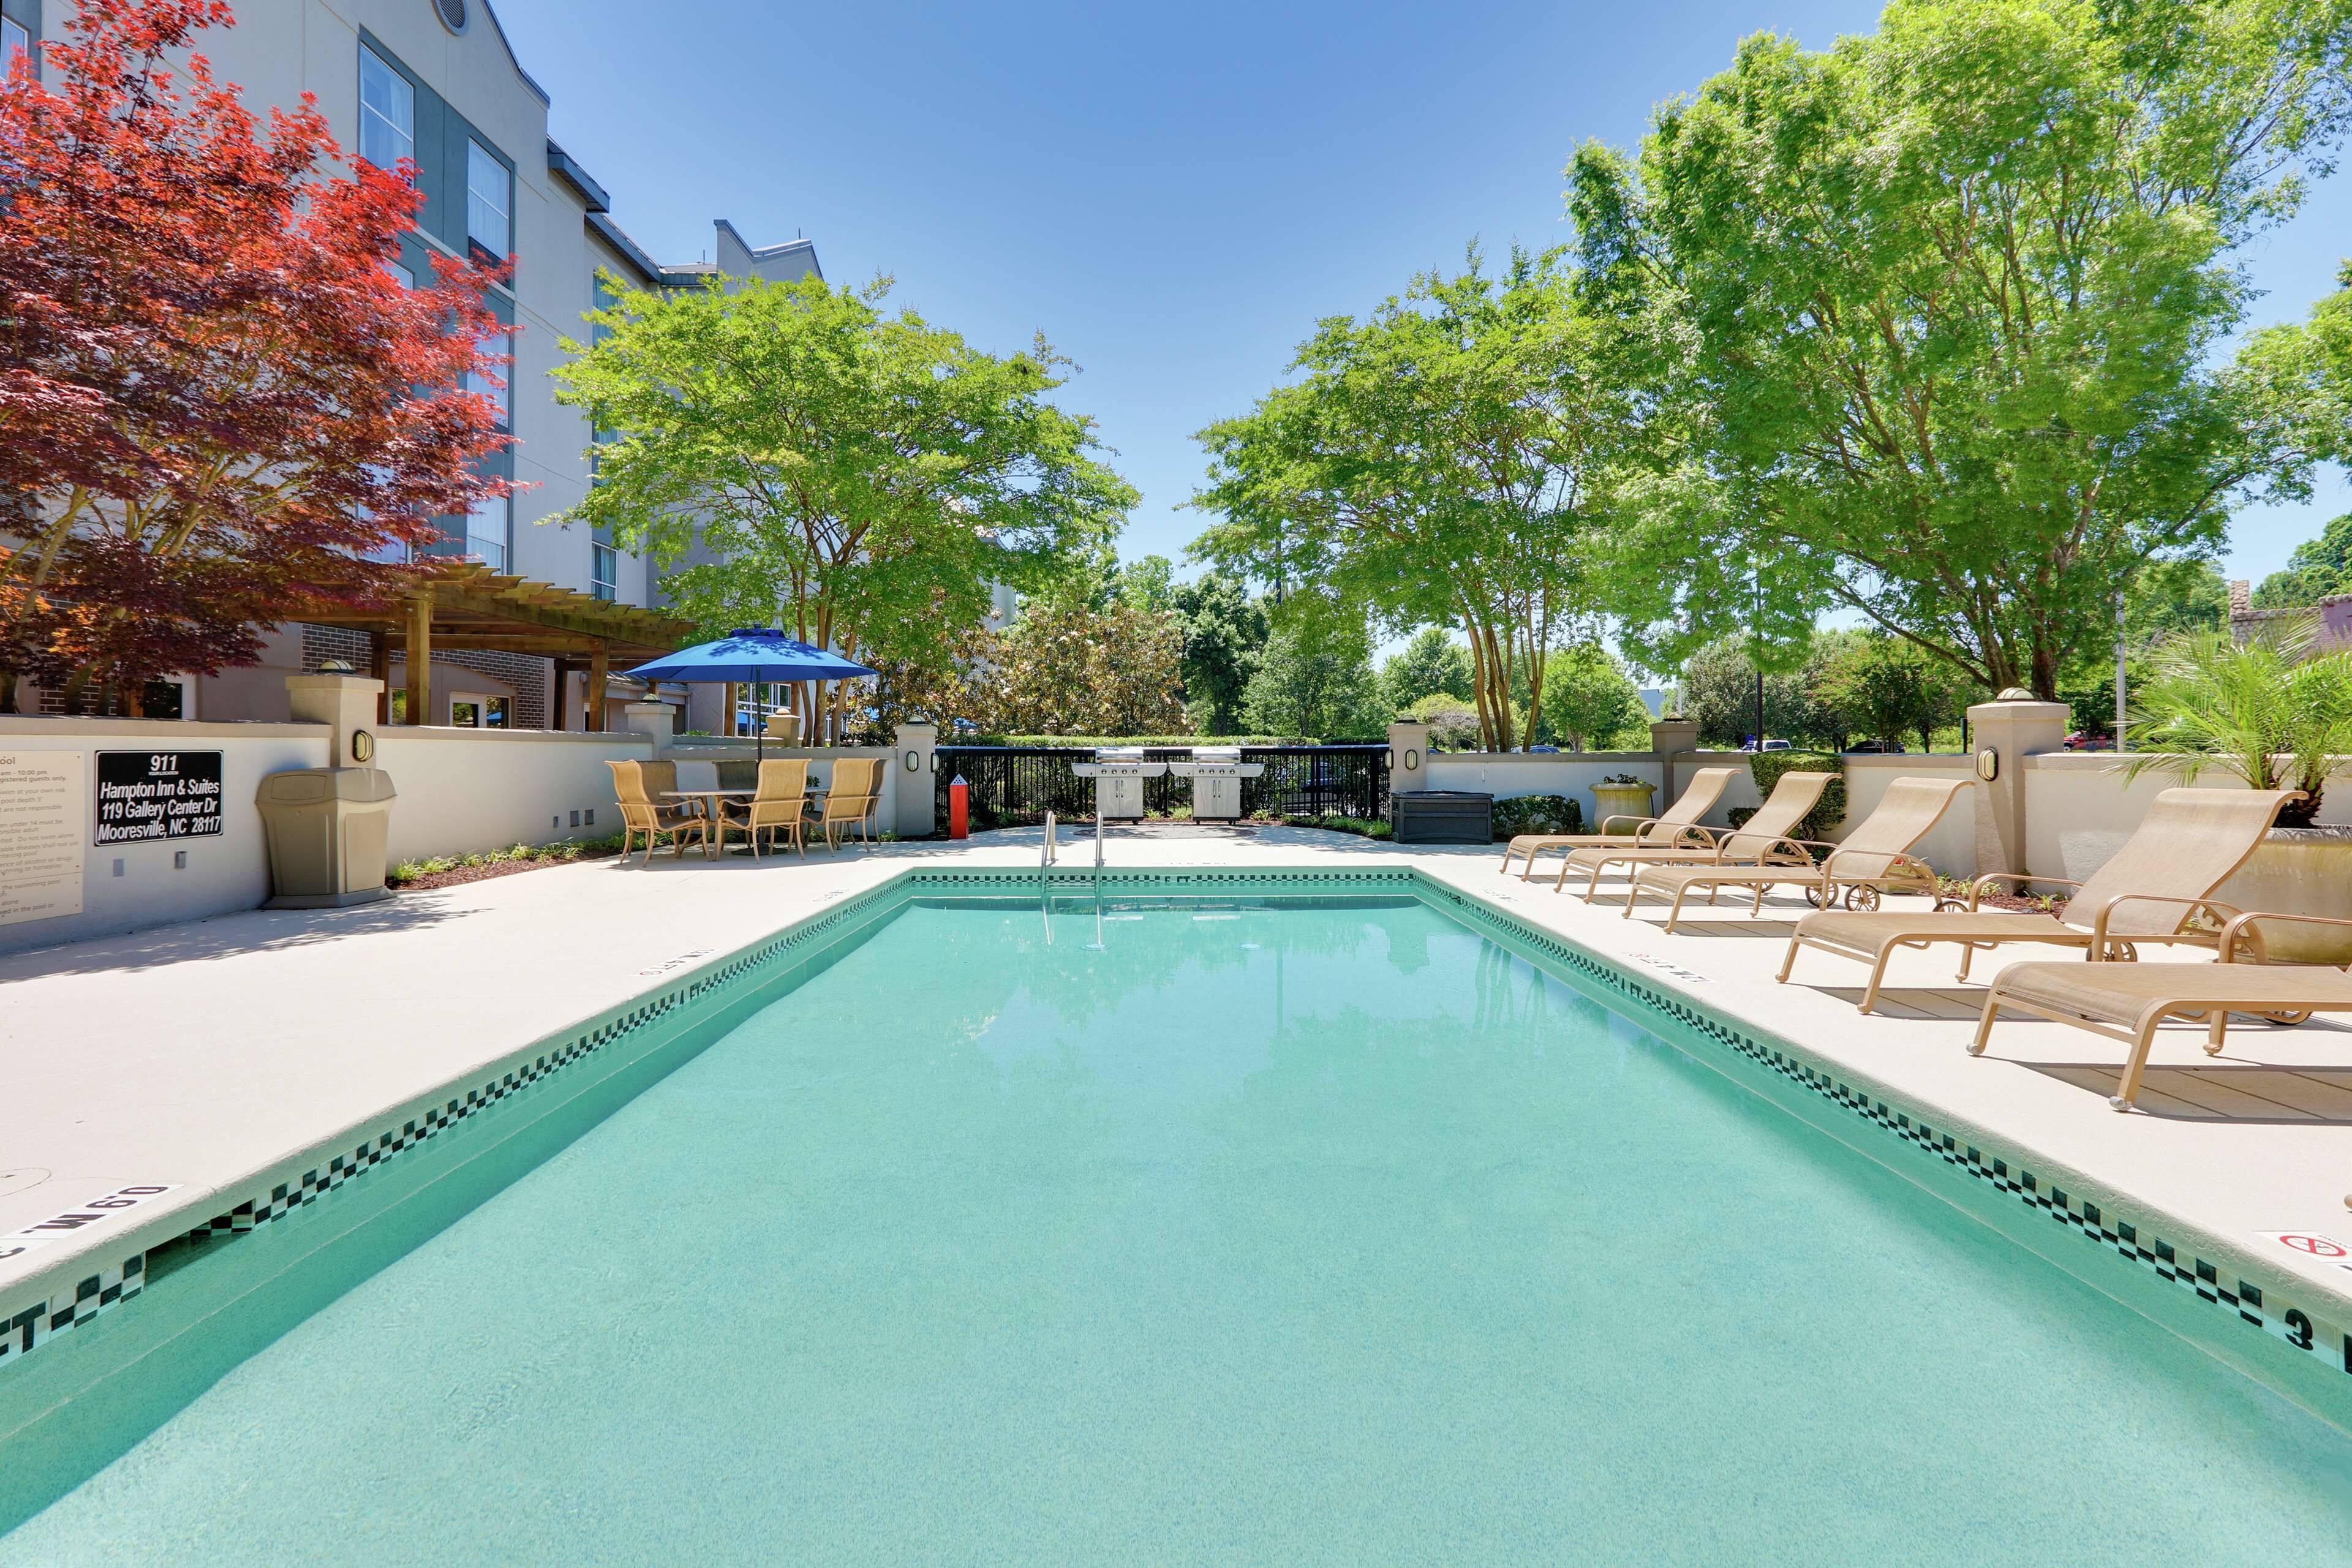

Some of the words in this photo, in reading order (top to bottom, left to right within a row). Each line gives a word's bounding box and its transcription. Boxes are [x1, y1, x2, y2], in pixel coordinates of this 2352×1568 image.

[150, 755, 178, 771] 911
[100, 782, 155, 802] Hampton
[156, 780, 175, 796] Inn
[176, 779, 186, 795] &
[187, 778, 220, 794] Suites
[102, 802, 123, 820] 119
[126, 801, 166, 820] Gallery
[167, 799, 203, 815] Center
[204, 797, 218, 813] Dr
[98, 820, 168, 841] Mooresville,
[170, 818, 187, 835] NC
[191, 816, 221, 833] 28117
[690, 981, 701, 1000] FT
[2285, 1308, 2313, 1351] 3
